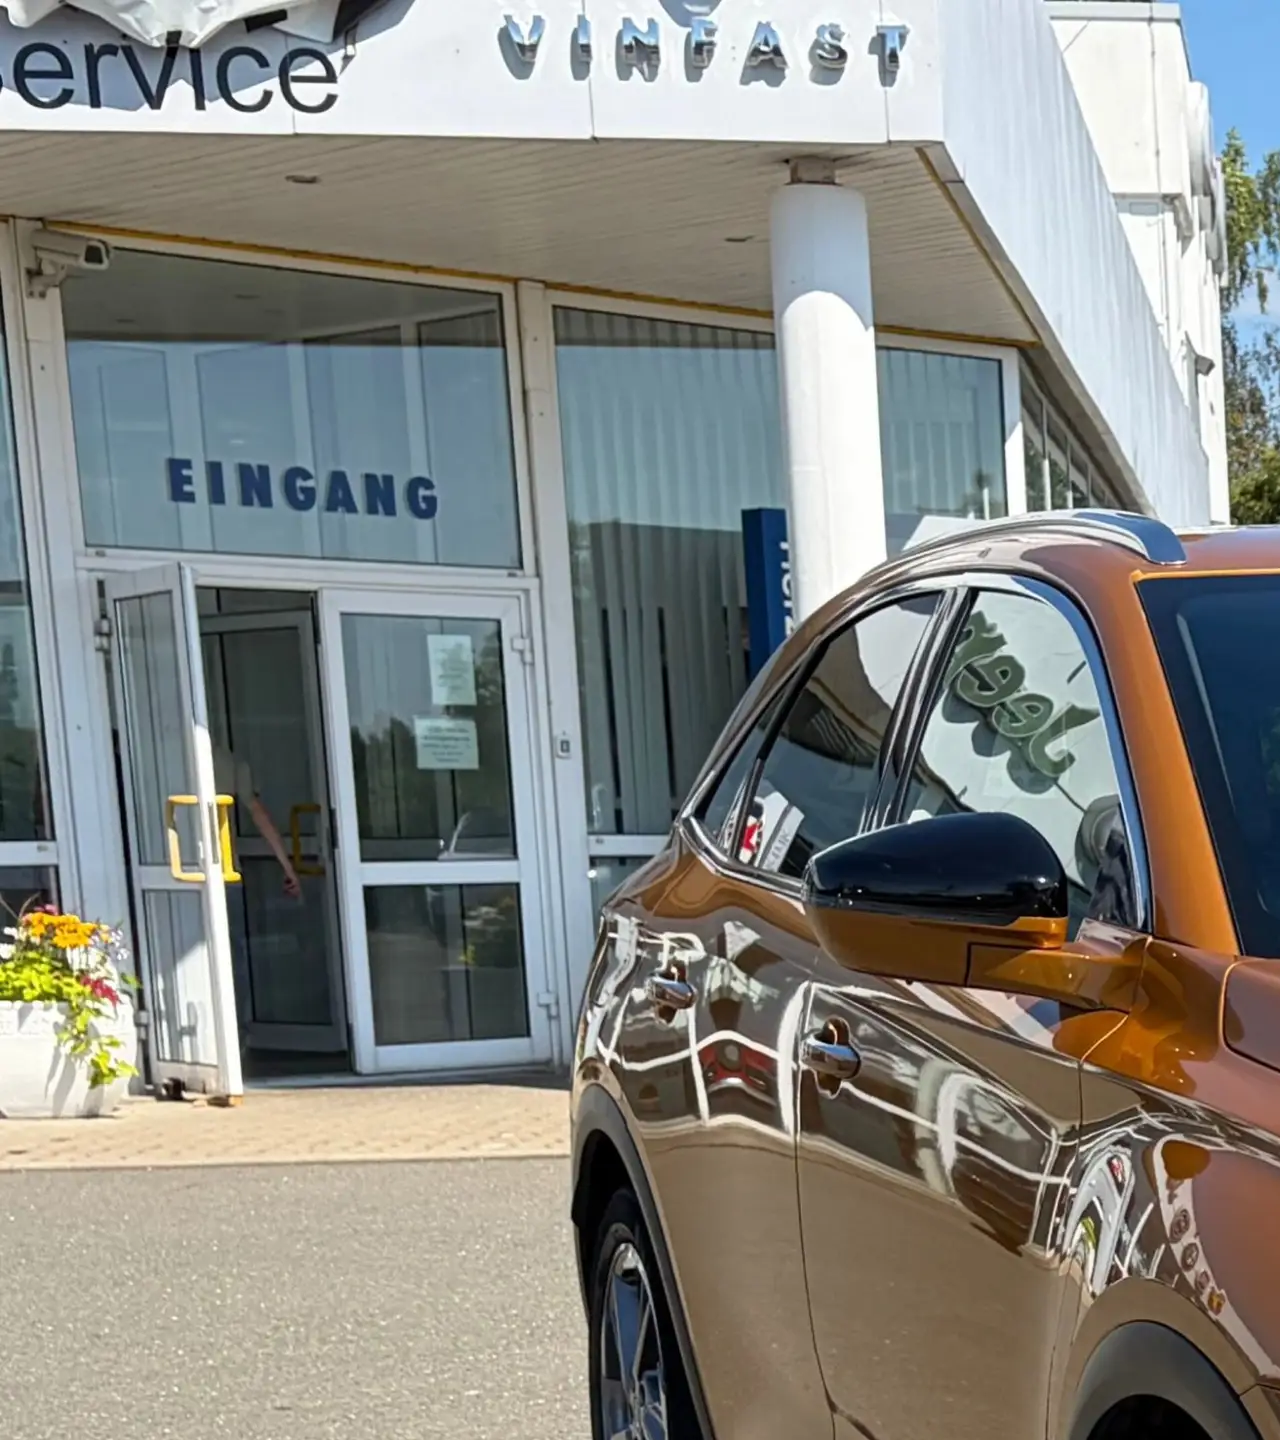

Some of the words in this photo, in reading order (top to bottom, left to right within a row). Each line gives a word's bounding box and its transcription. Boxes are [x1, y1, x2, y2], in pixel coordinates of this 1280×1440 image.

[503, 14, 909, 71] VINFAST
[0, 41, 339, 114] ervice
[168, 458, 438, 519] EINGANG
